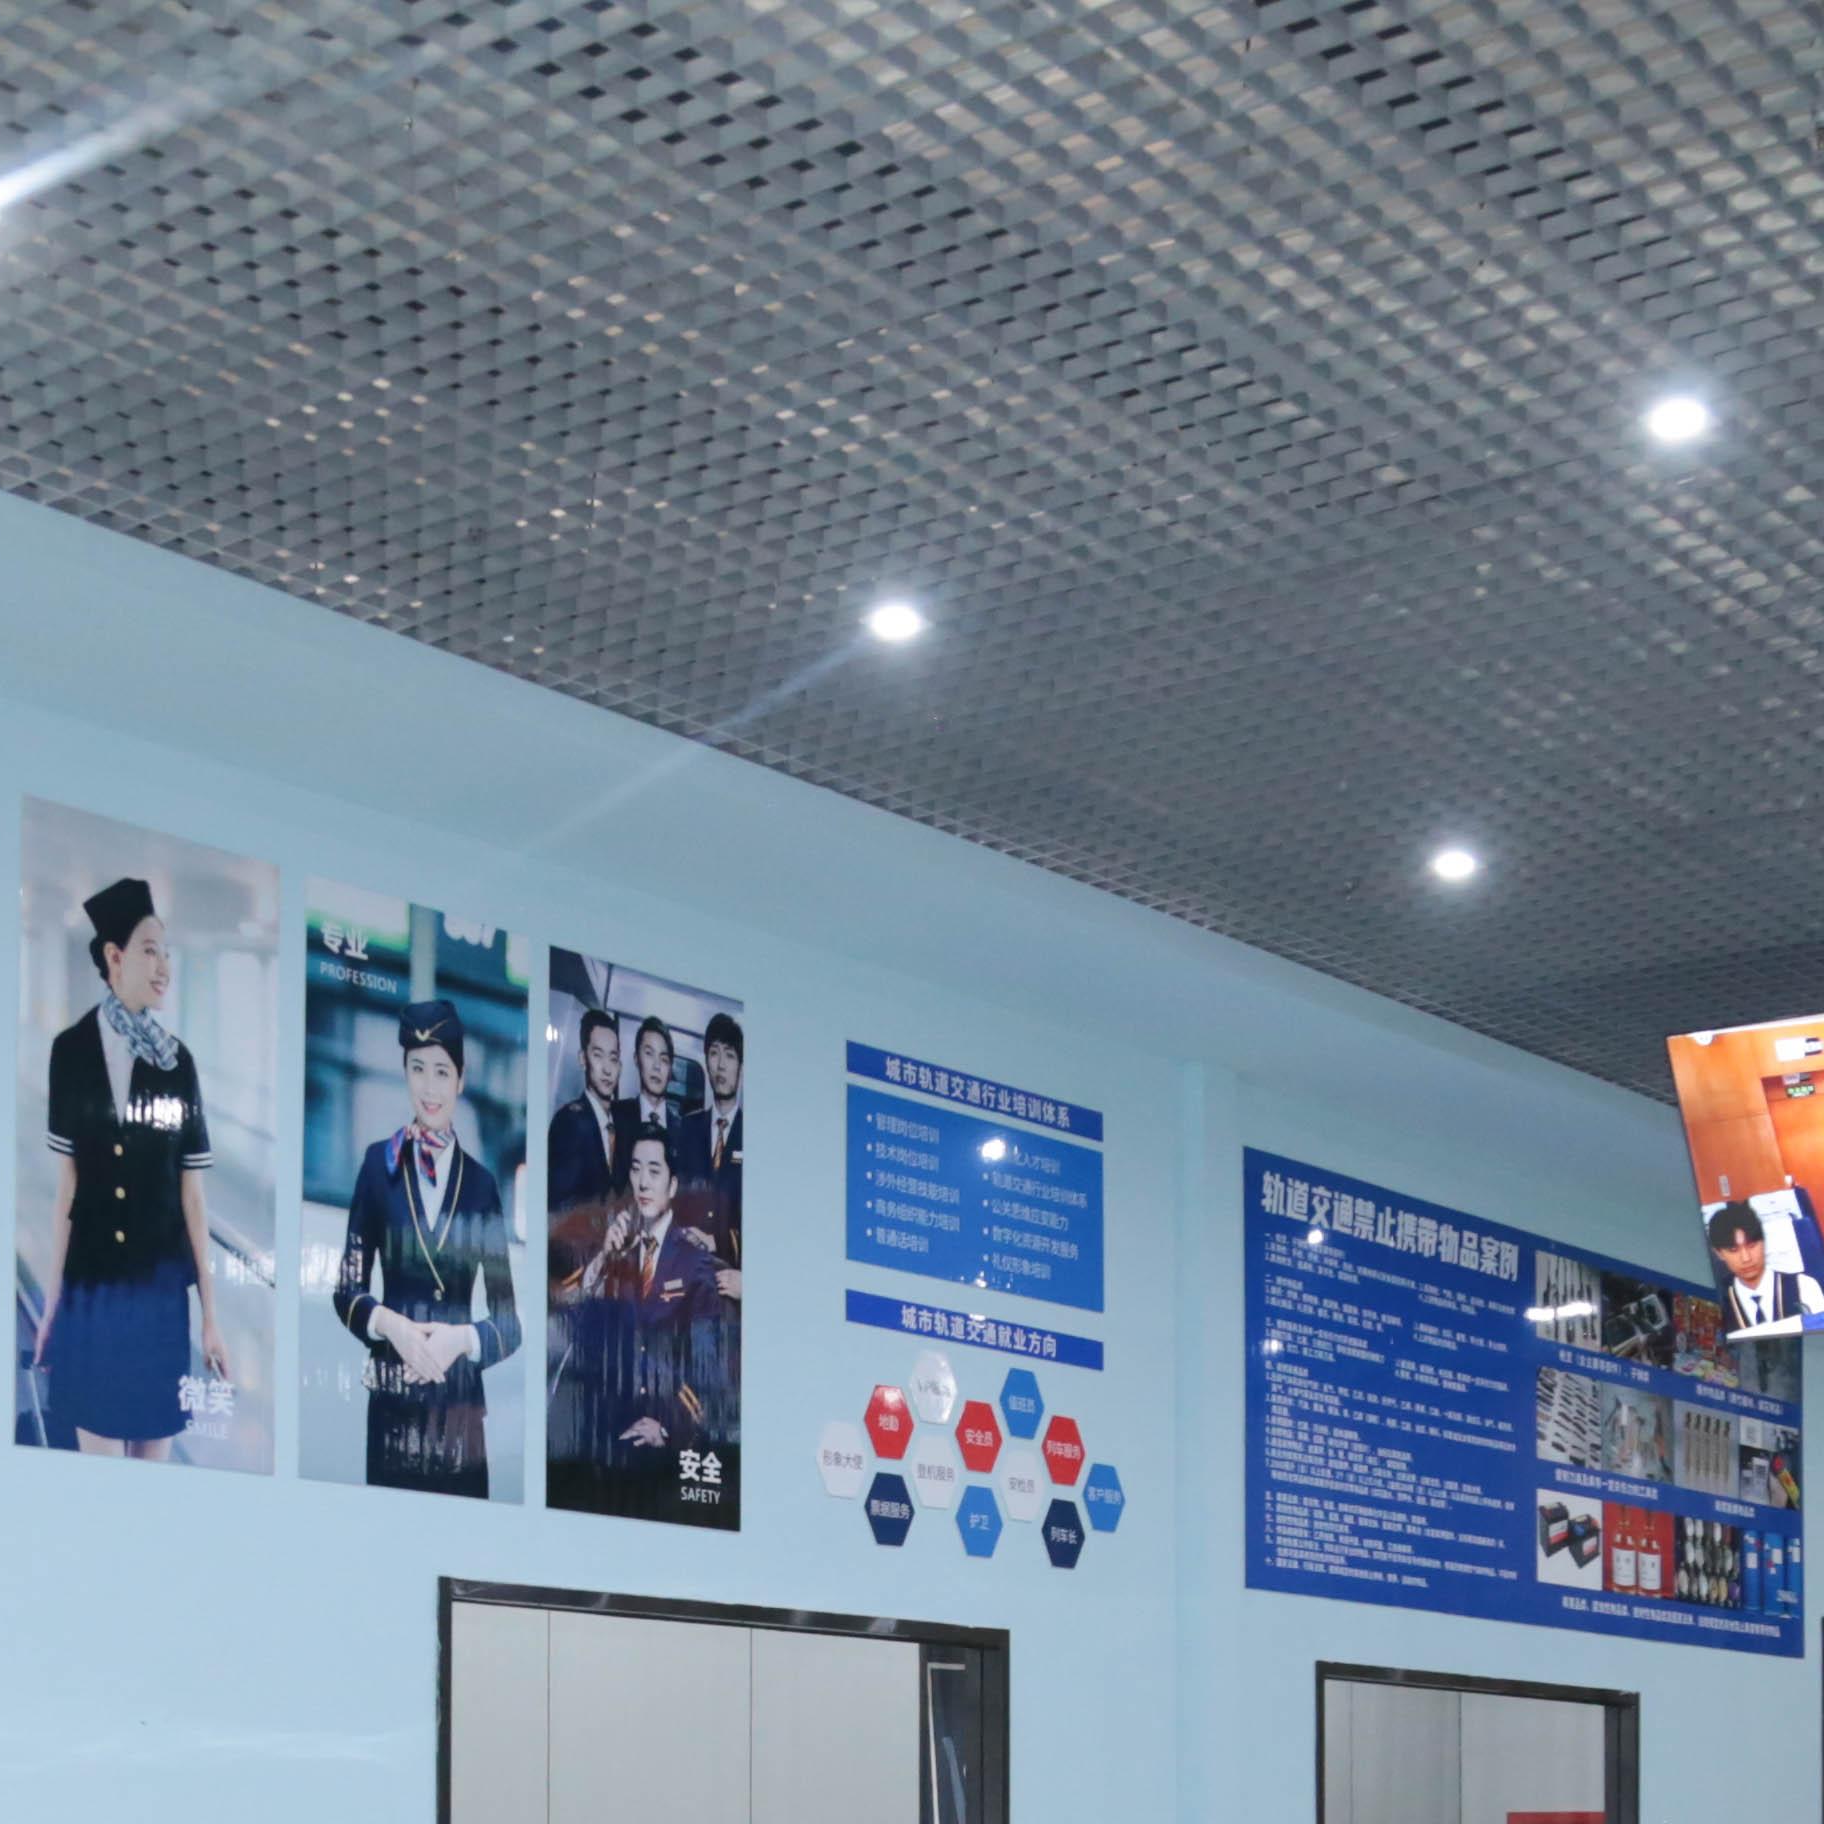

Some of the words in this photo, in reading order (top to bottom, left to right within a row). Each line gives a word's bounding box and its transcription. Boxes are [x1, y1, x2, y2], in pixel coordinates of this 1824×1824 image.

[320, 921, 369, 961] 专业
[320, 961, 397, 994] PROFESSION
[886, 1056, 1070, 1128] 城市轨道交通行业培训体系
[1261, 1170, 1520, 1283] 轨道交通禁止携带物品案例
[901, 1305, 1058, 1358] 城市轨道交通就业方向
[178, 1374, 234, 1416] 微笑
[679, 1449, 723, 1484] 安全
[680, 1486, 721, 1505] SAFETY
